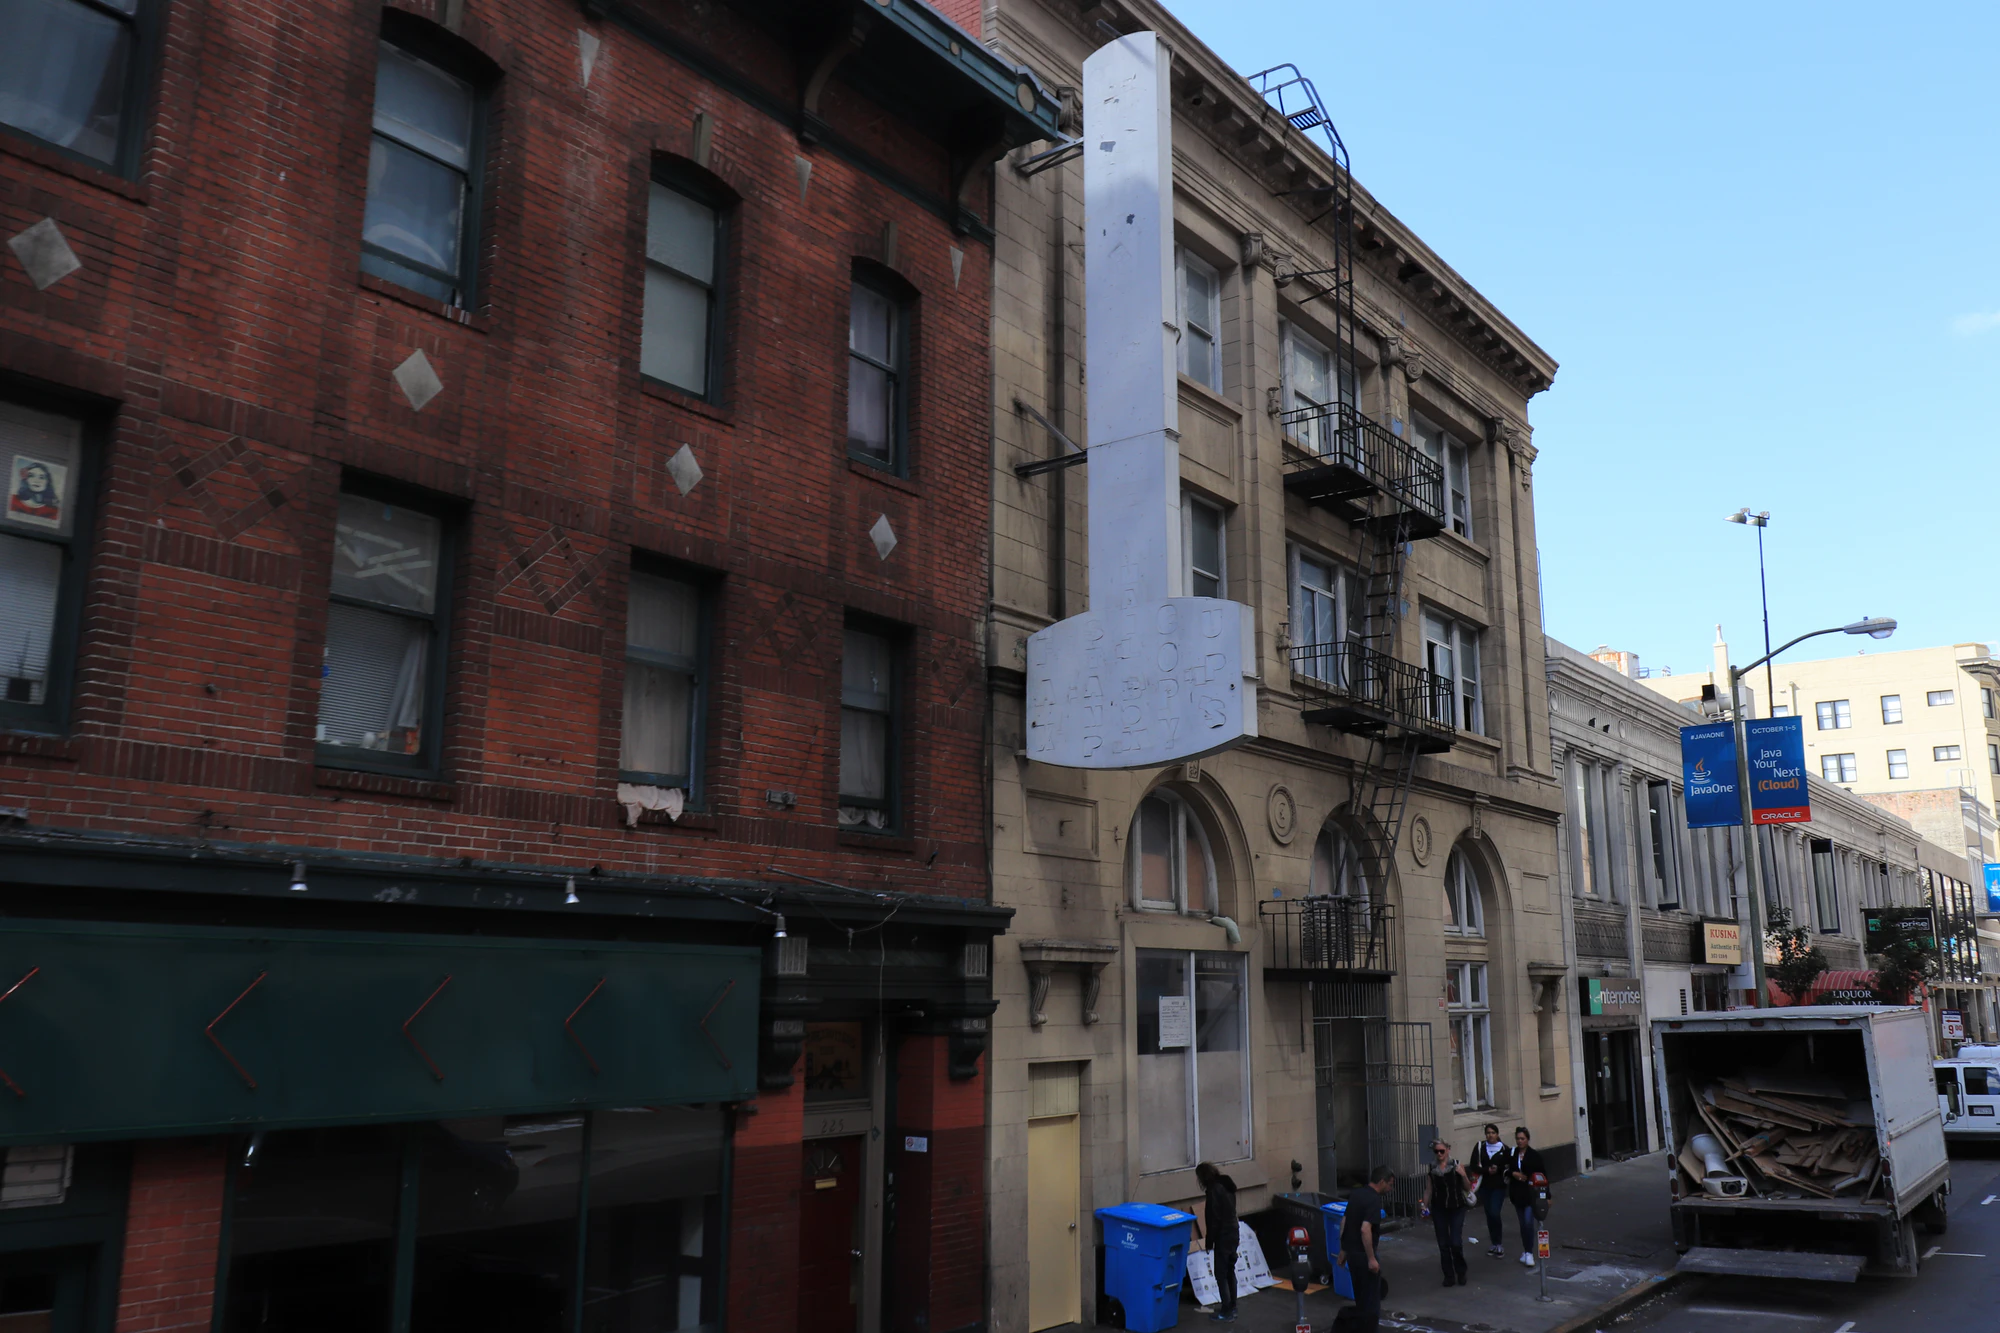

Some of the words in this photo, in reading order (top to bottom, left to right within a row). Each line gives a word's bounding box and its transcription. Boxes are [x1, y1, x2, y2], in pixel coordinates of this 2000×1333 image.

[1690, 731, 1724, 739] #JAVAONE
[1752, 726, 1784, 734] OCTOBER
[1760, 748, 1782, 760] Java
[1753, 759, 1777, 769] Your
[1773, 766, 1801, 778] Next
[1691, 784, 1734, 796] JavaOne
[1758, 777, 1799, 793] (Cloud)
[1761, 812, 1802, 820] ORACLE
[1710, 929, 1738, 940] KUSINA
[1832, 990, 1873, 1000] LIQUOR
[1947, 1024, 1955, 1036] 9
[821, 1119, 844, 1133] 225
